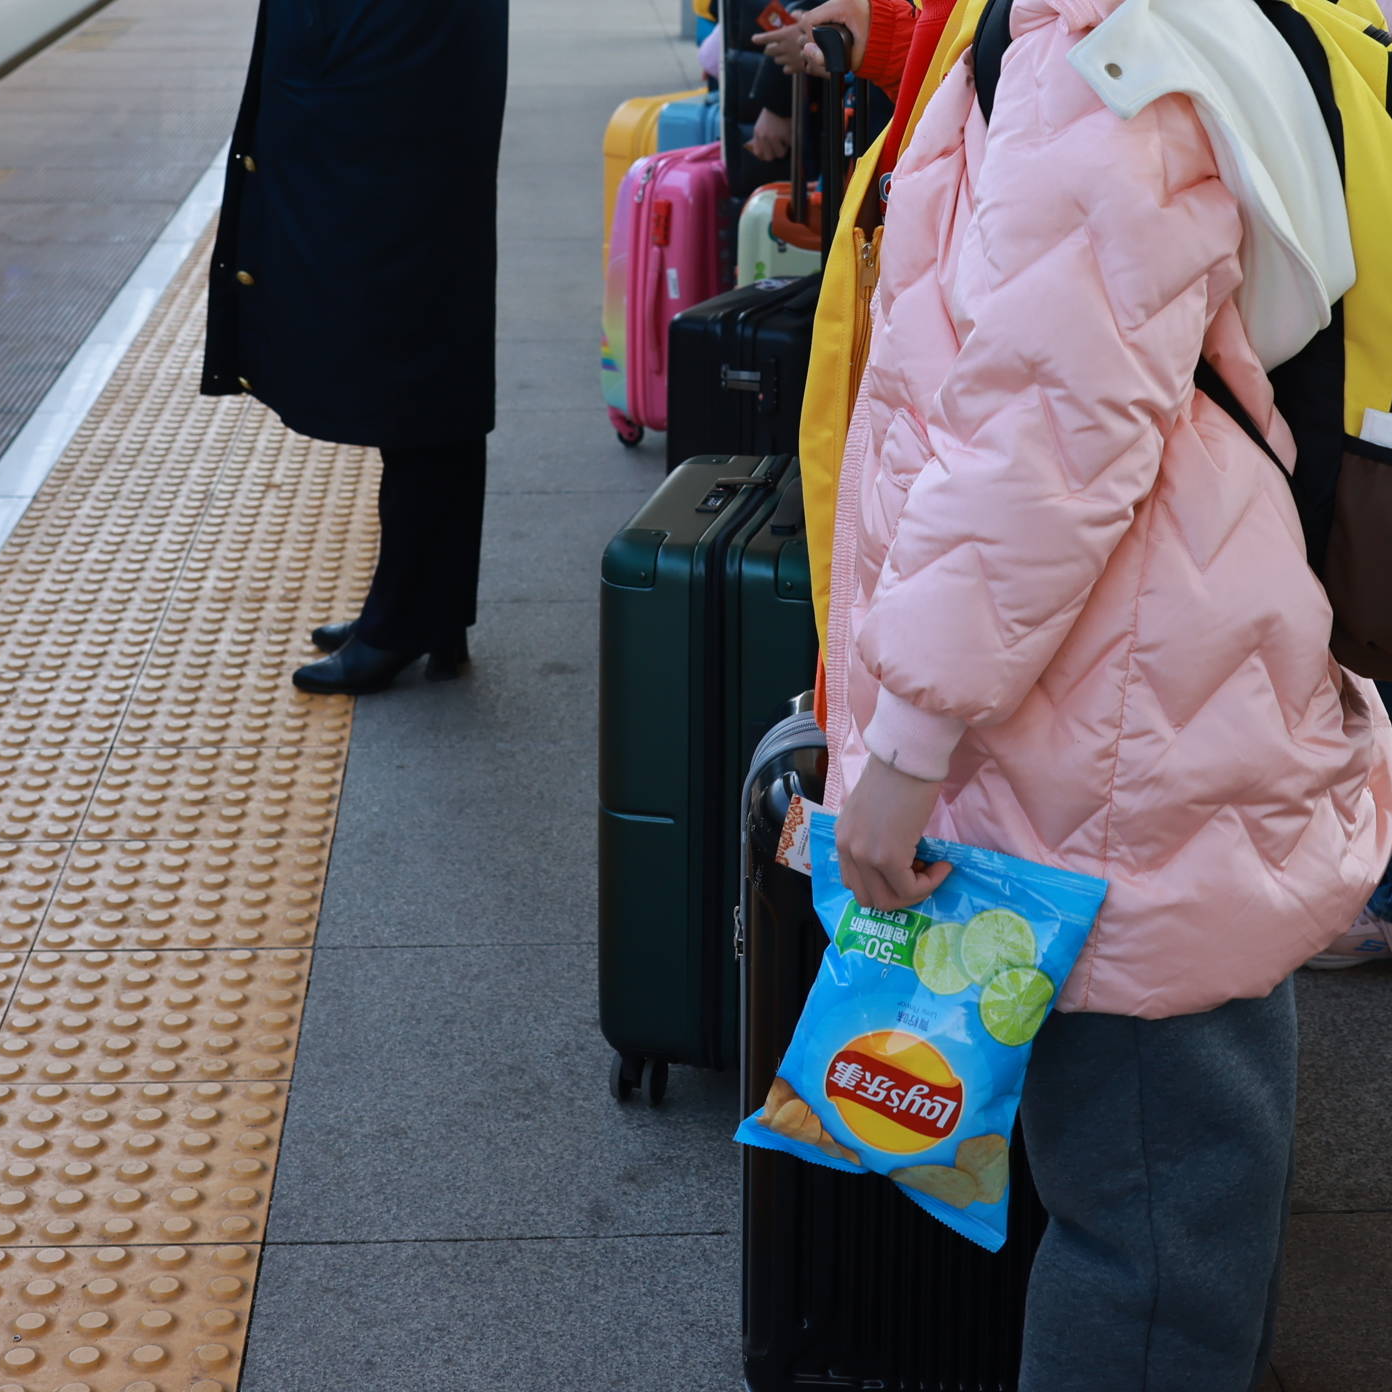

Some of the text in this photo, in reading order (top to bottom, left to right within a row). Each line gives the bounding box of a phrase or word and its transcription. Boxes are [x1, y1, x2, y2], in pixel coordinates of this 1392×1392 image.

[848, 916, 909, 946] 饱和脂肪
[856, 935, 902, 965] -50%
[828, 1061, 896, 1102] 乐事
